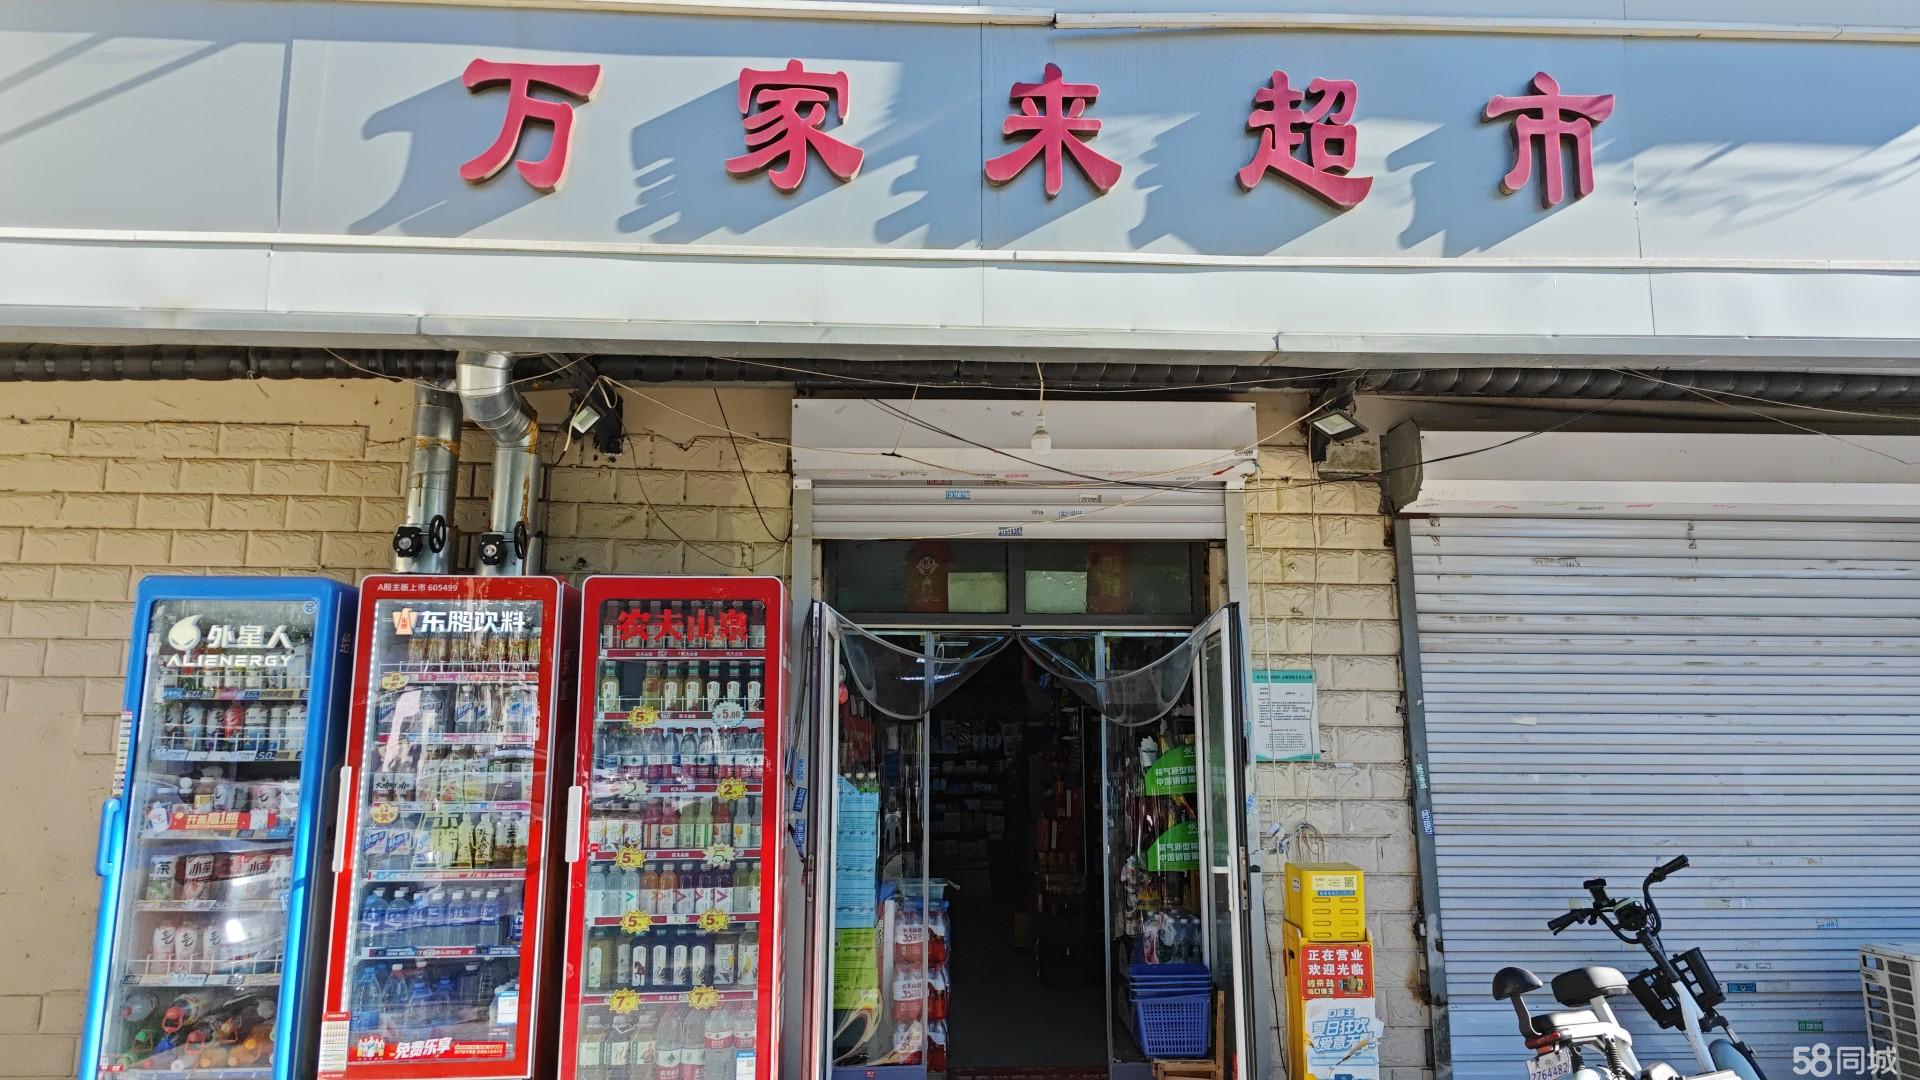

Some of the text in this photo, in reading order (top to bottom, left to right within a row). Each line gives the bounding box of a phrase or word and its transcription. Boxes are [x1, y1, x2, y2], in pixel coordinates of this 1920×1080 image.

[459, 58, 1616, 208] 万家来超市
[377, 583, 458, 592] A股主板上市 605499
[421, 610, 526, 633] 东鹏饮料
[617, 608, 747, 641] 农夫山泉
[206, 624, 293, 649] 外星人
[166, 654, 293, 668] ALIENERGY
[1307, 949, 1363, 961] 正在营业
[1308, 963, 1364, 976] 欢迎光临
[1312, 1018, 1369, 1037] 夏日狂欢
[394, 1037, 452, 1059] 免费乐享
